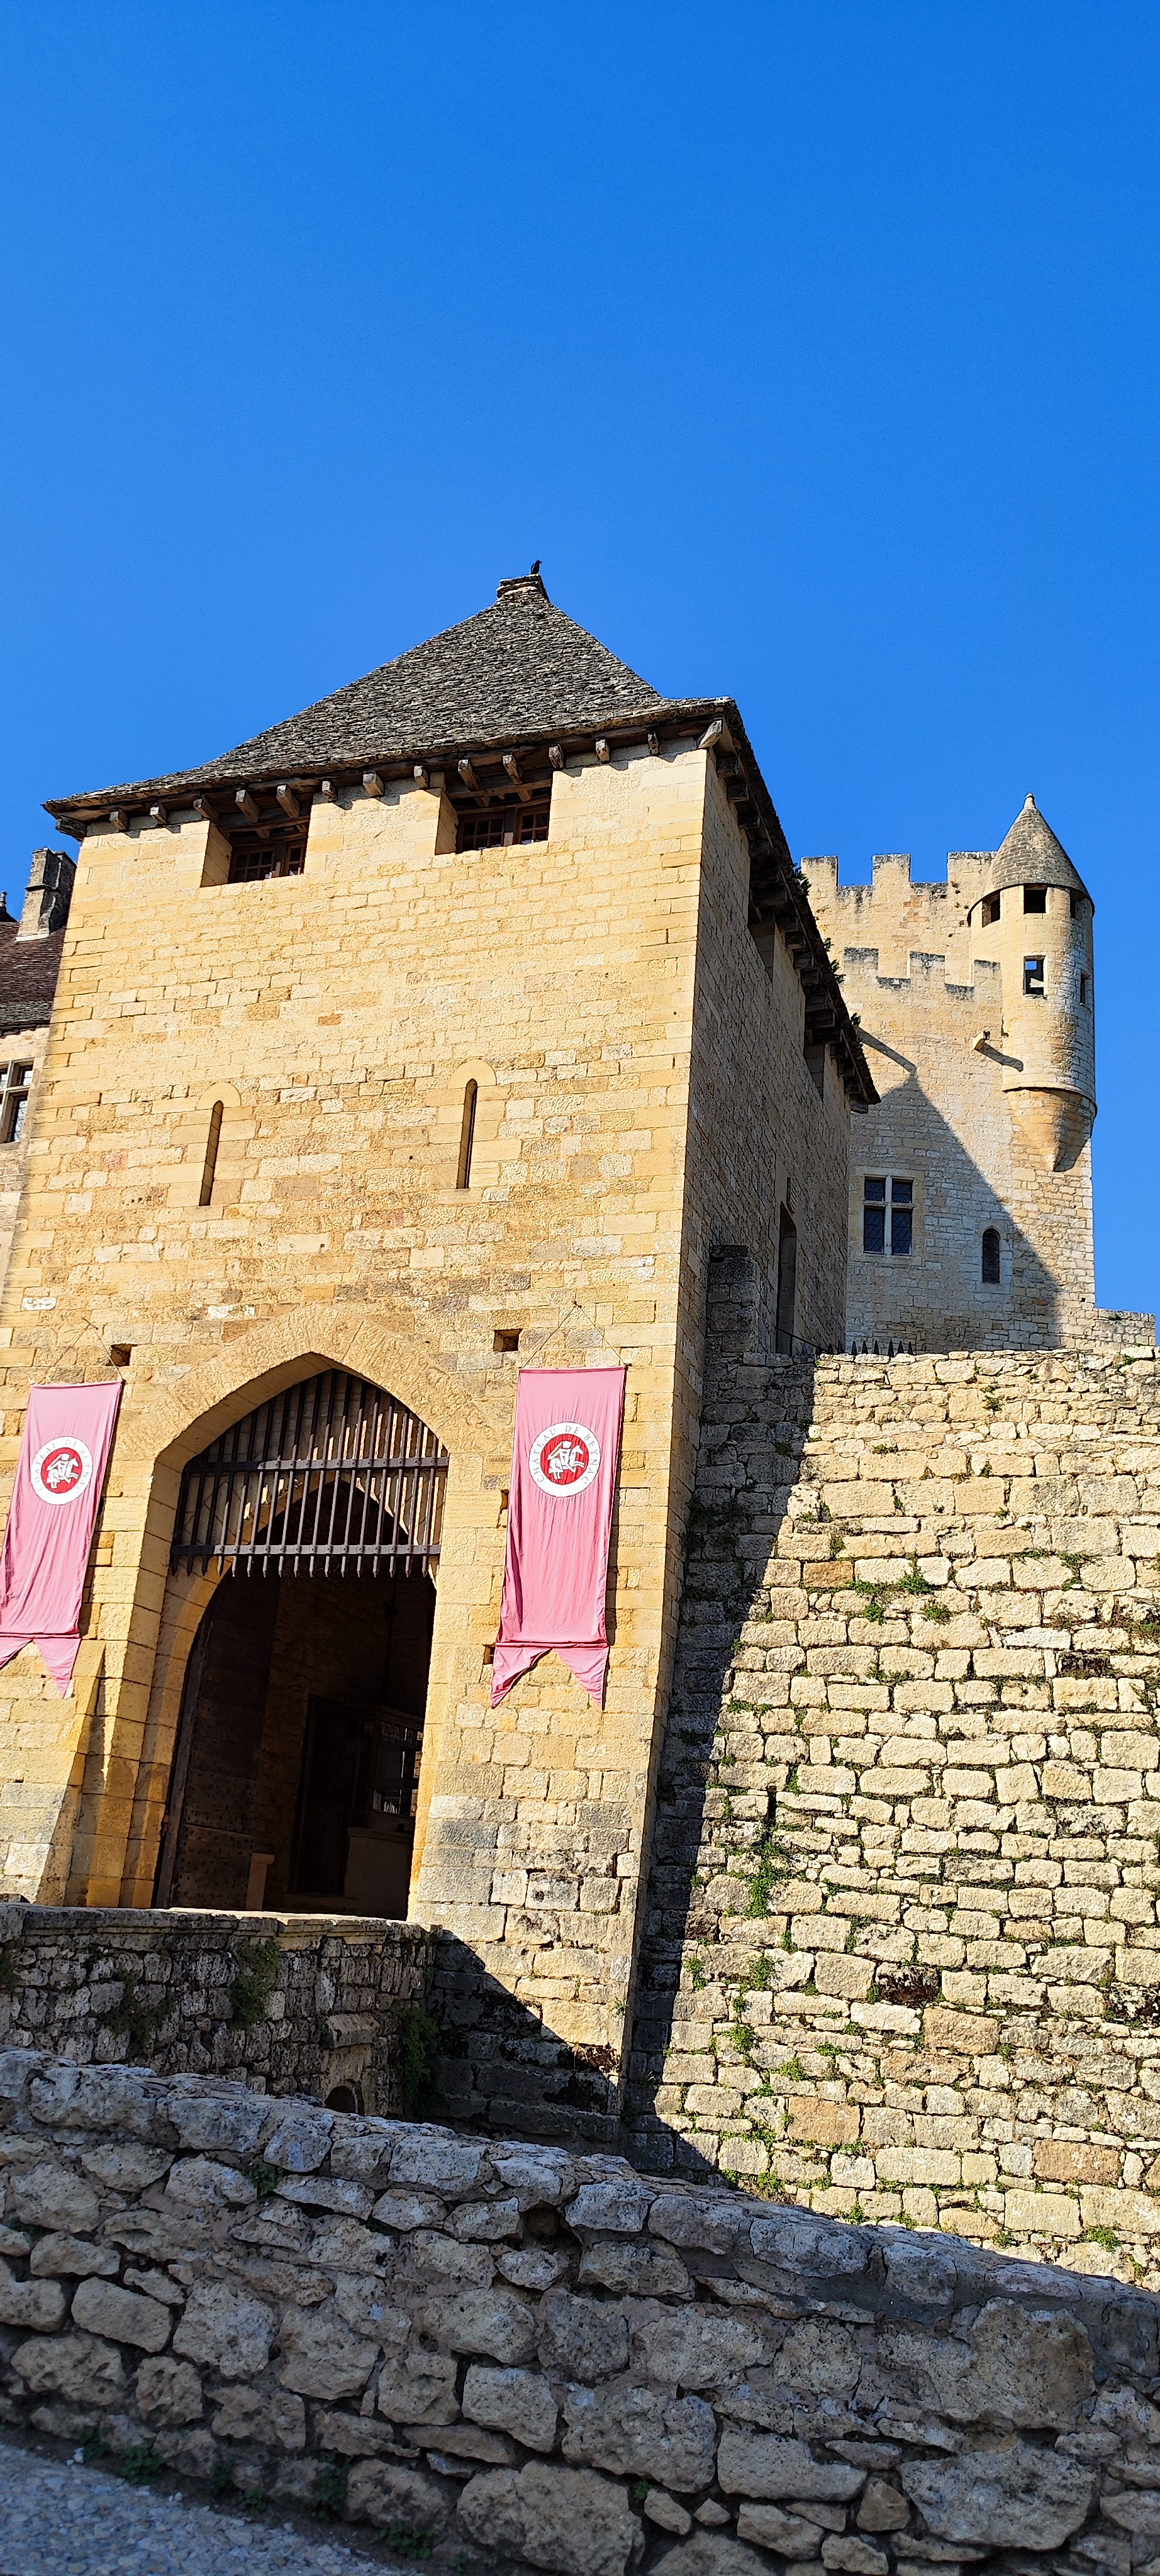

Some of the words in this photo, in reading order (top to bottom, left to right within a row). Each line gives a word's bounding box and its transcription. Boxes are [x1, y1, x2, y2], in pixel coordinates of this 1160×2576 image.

[65, 1439, 77, 1448] DE
[532, 1428, 557, 1482] CHATEAU
[565, 1425, 580, 1435] DE
[581, 1433, 598, 1484] BEYNAC
